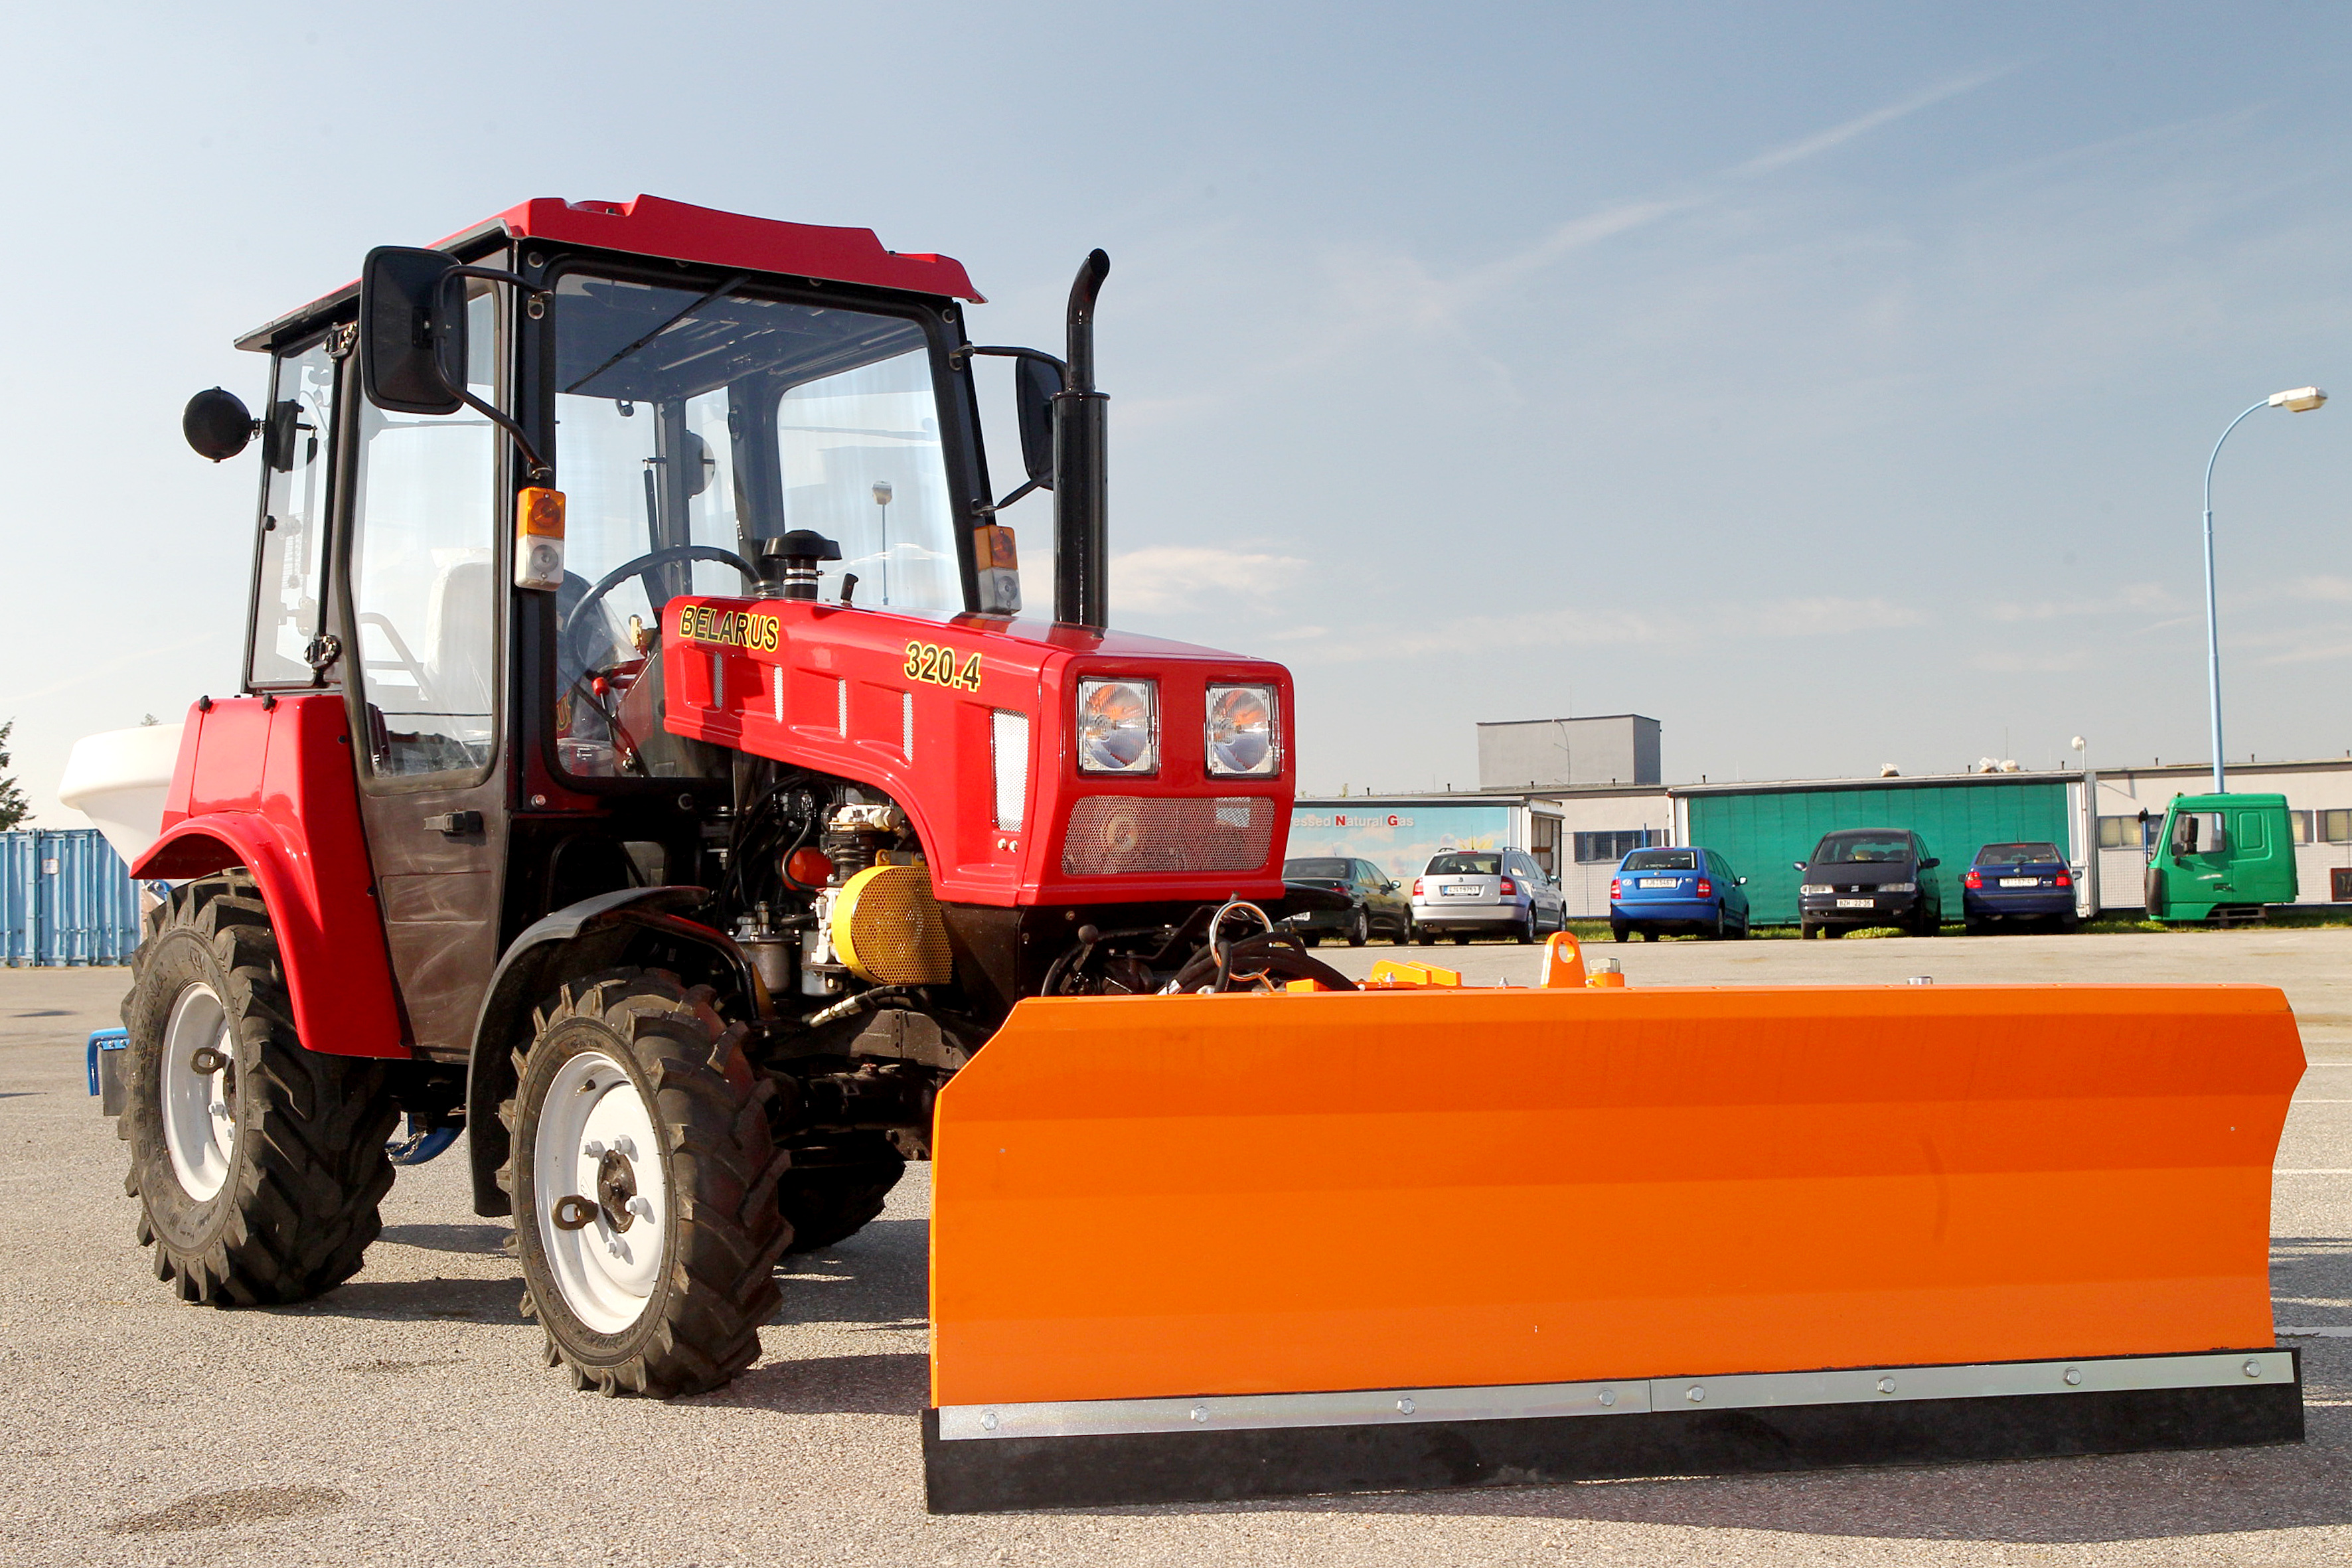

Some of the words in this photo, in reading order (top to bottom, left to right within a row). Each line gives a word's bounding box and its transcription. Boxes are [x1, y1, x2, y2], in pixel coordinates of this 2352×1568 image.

[679, 605, 779, 653] BELARUS
[904, 641, 982, 692] 320.4
[1334, 814, 1383, 827] Natural
[1387, 814, 1415, 827] Gas
